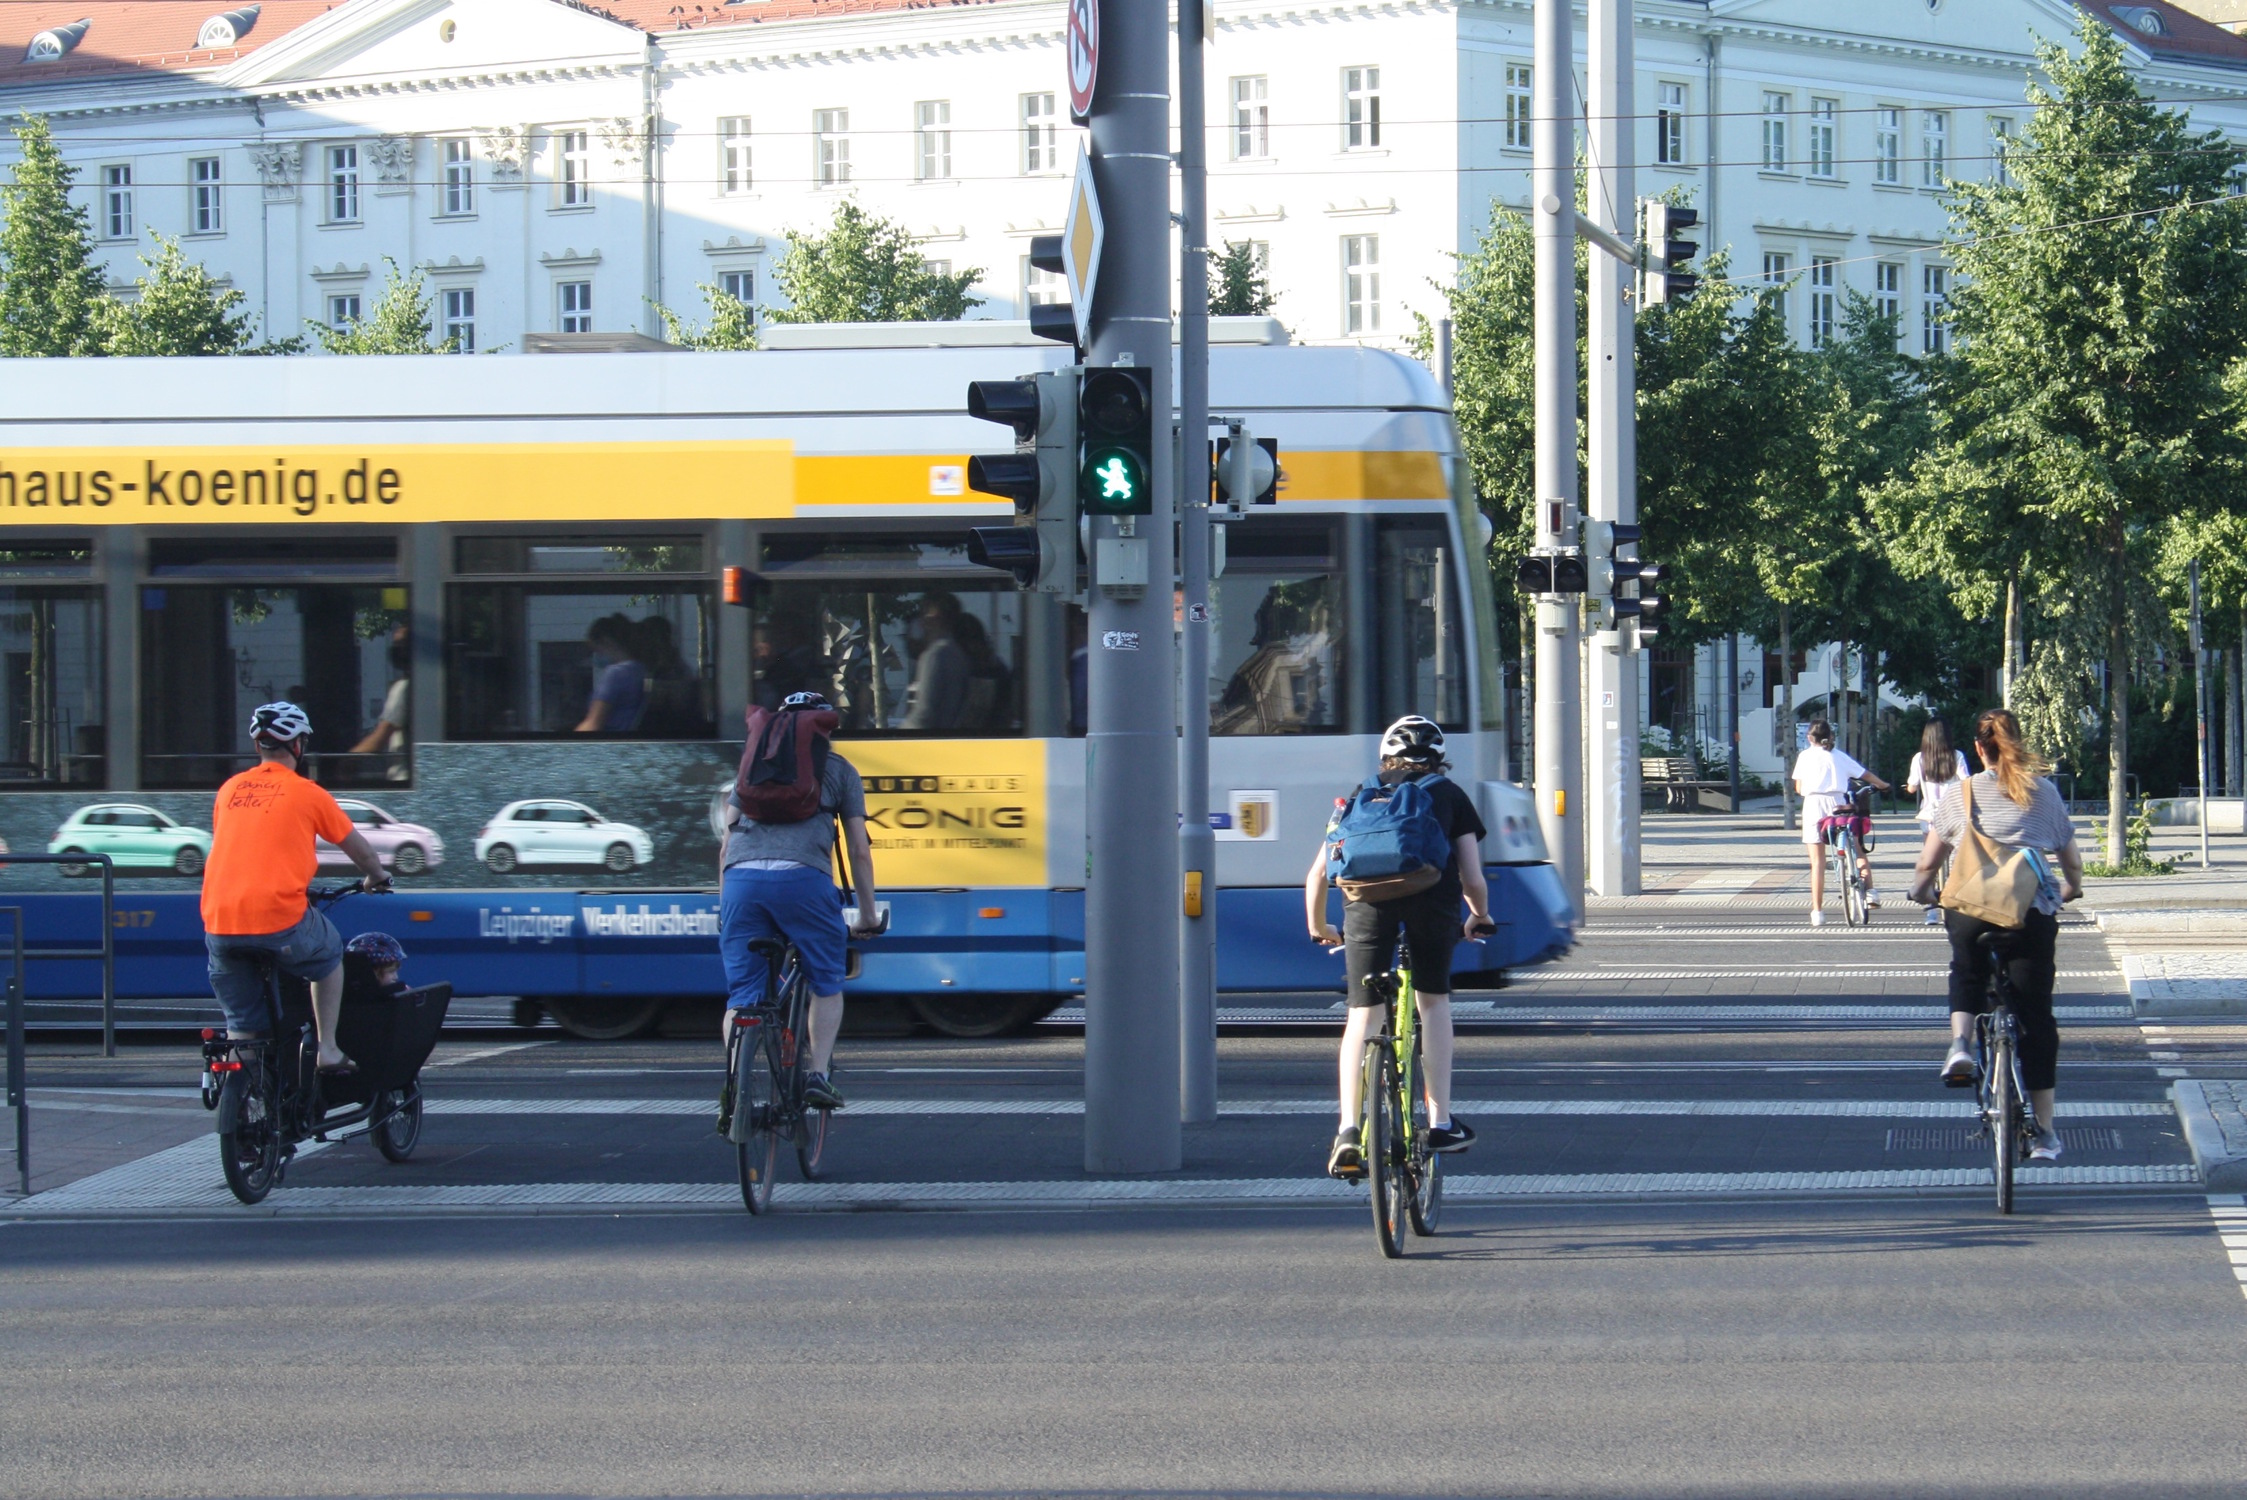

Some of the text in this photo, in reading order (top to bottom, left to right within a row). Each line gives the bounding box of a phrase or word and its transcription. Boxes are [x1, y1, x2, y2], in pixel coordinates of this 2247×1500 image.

[0, 458, 402, 516] haus-koenig.de
[865, 800, 1025, 829] KÖNIG
[871, 837, 918, 849] BILITÄT
[479, 904, 720, 944] Leipziger Verkehrsbetri
